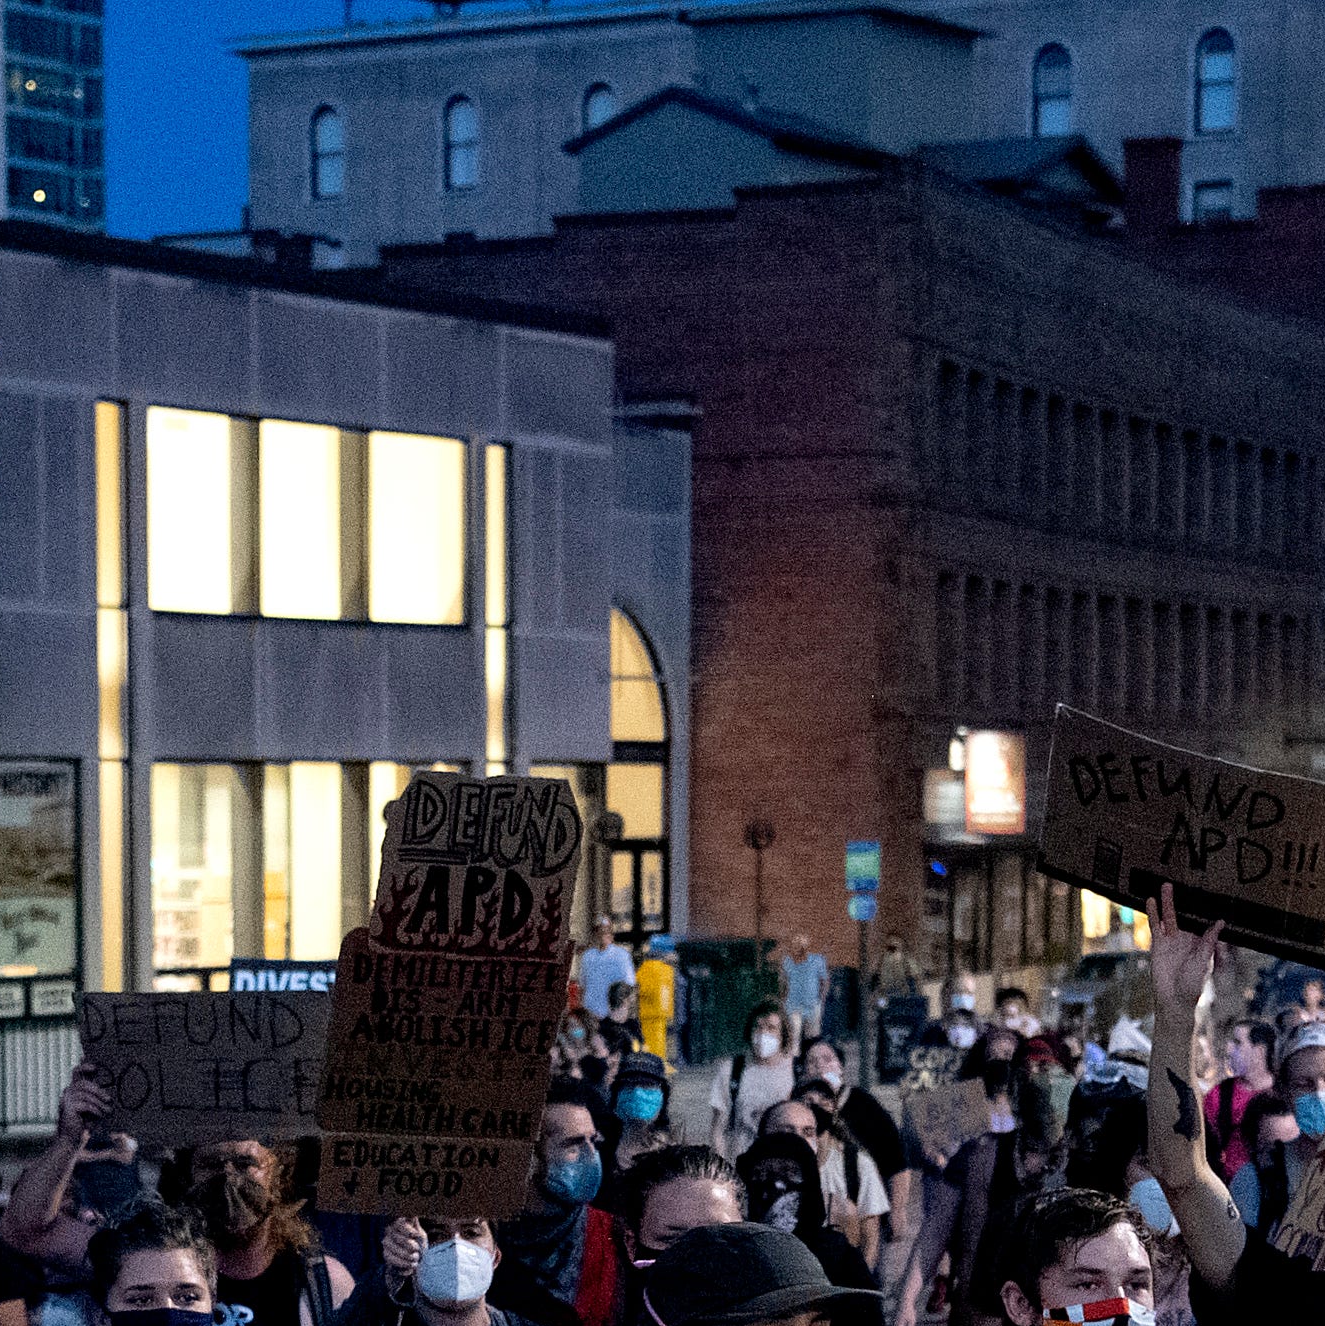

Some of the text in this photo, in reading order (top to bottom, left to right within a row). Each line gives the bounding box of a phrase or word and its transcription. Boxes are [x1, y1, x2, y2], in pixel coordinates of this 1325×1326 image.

[1069, 752, 1284, 830] DEFUND
[401, 783, 582, 876] DEFUND
[1161, 811, 1322, 889] APD!!!
[406, 866, 535, 937] APD
[234, 970, 337, 992] DIVES
[82, 997, 304, 1047] DEFUND
[350, 1014, 553, 1054] ABOLISH ICE
[324, 1074, 441, 1103] HOUSING
[358, 1101, 533, 1137] HEALTH CARE
[333, 1141, 499, 1168] EDUCATION
[378, 1171, 463, 1197] FOOD
